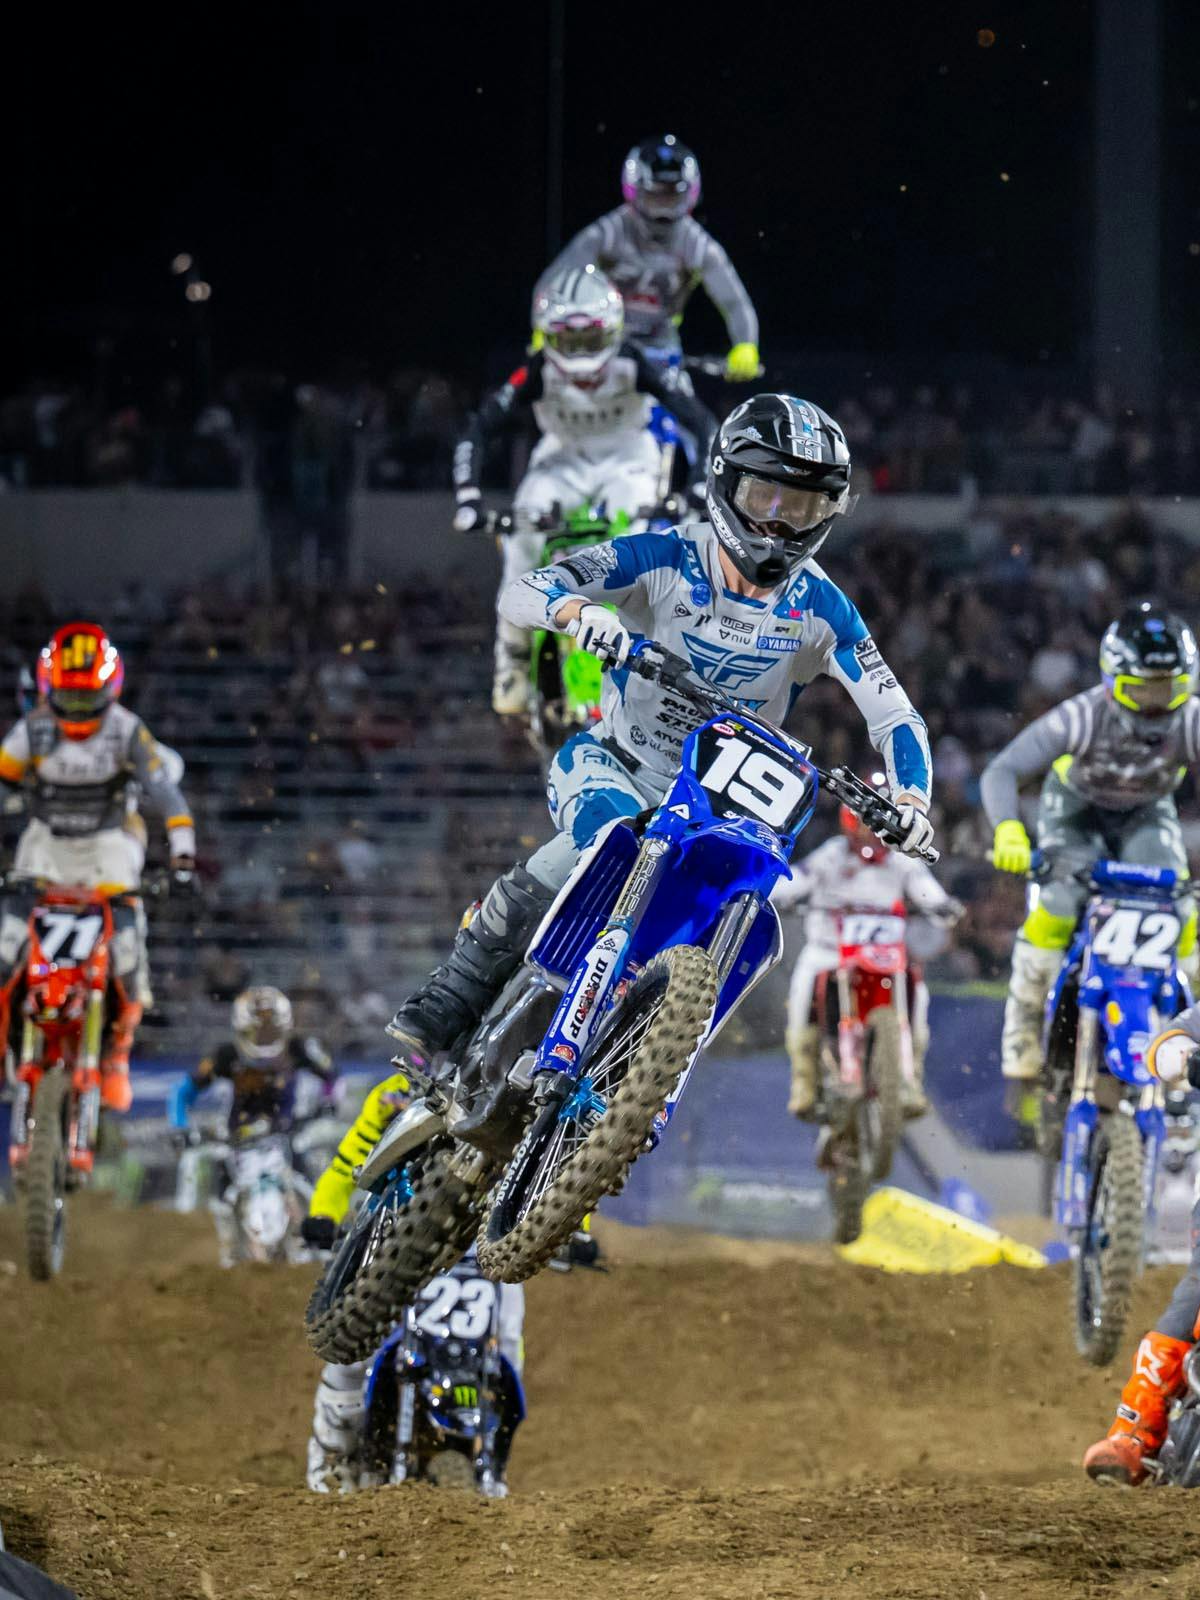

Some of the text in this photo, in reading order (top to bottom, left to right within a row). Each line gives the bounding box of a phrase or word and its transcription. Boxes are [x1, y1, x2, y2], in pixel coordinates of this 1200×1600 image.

[768, 639, 800, 651] YAMAH
[700, 737, 806, 827] 19
[41, 914, 103, 961] 71
[1092, 909, 1181, 969] 42
[416, 1276, 497, 1339] 23
